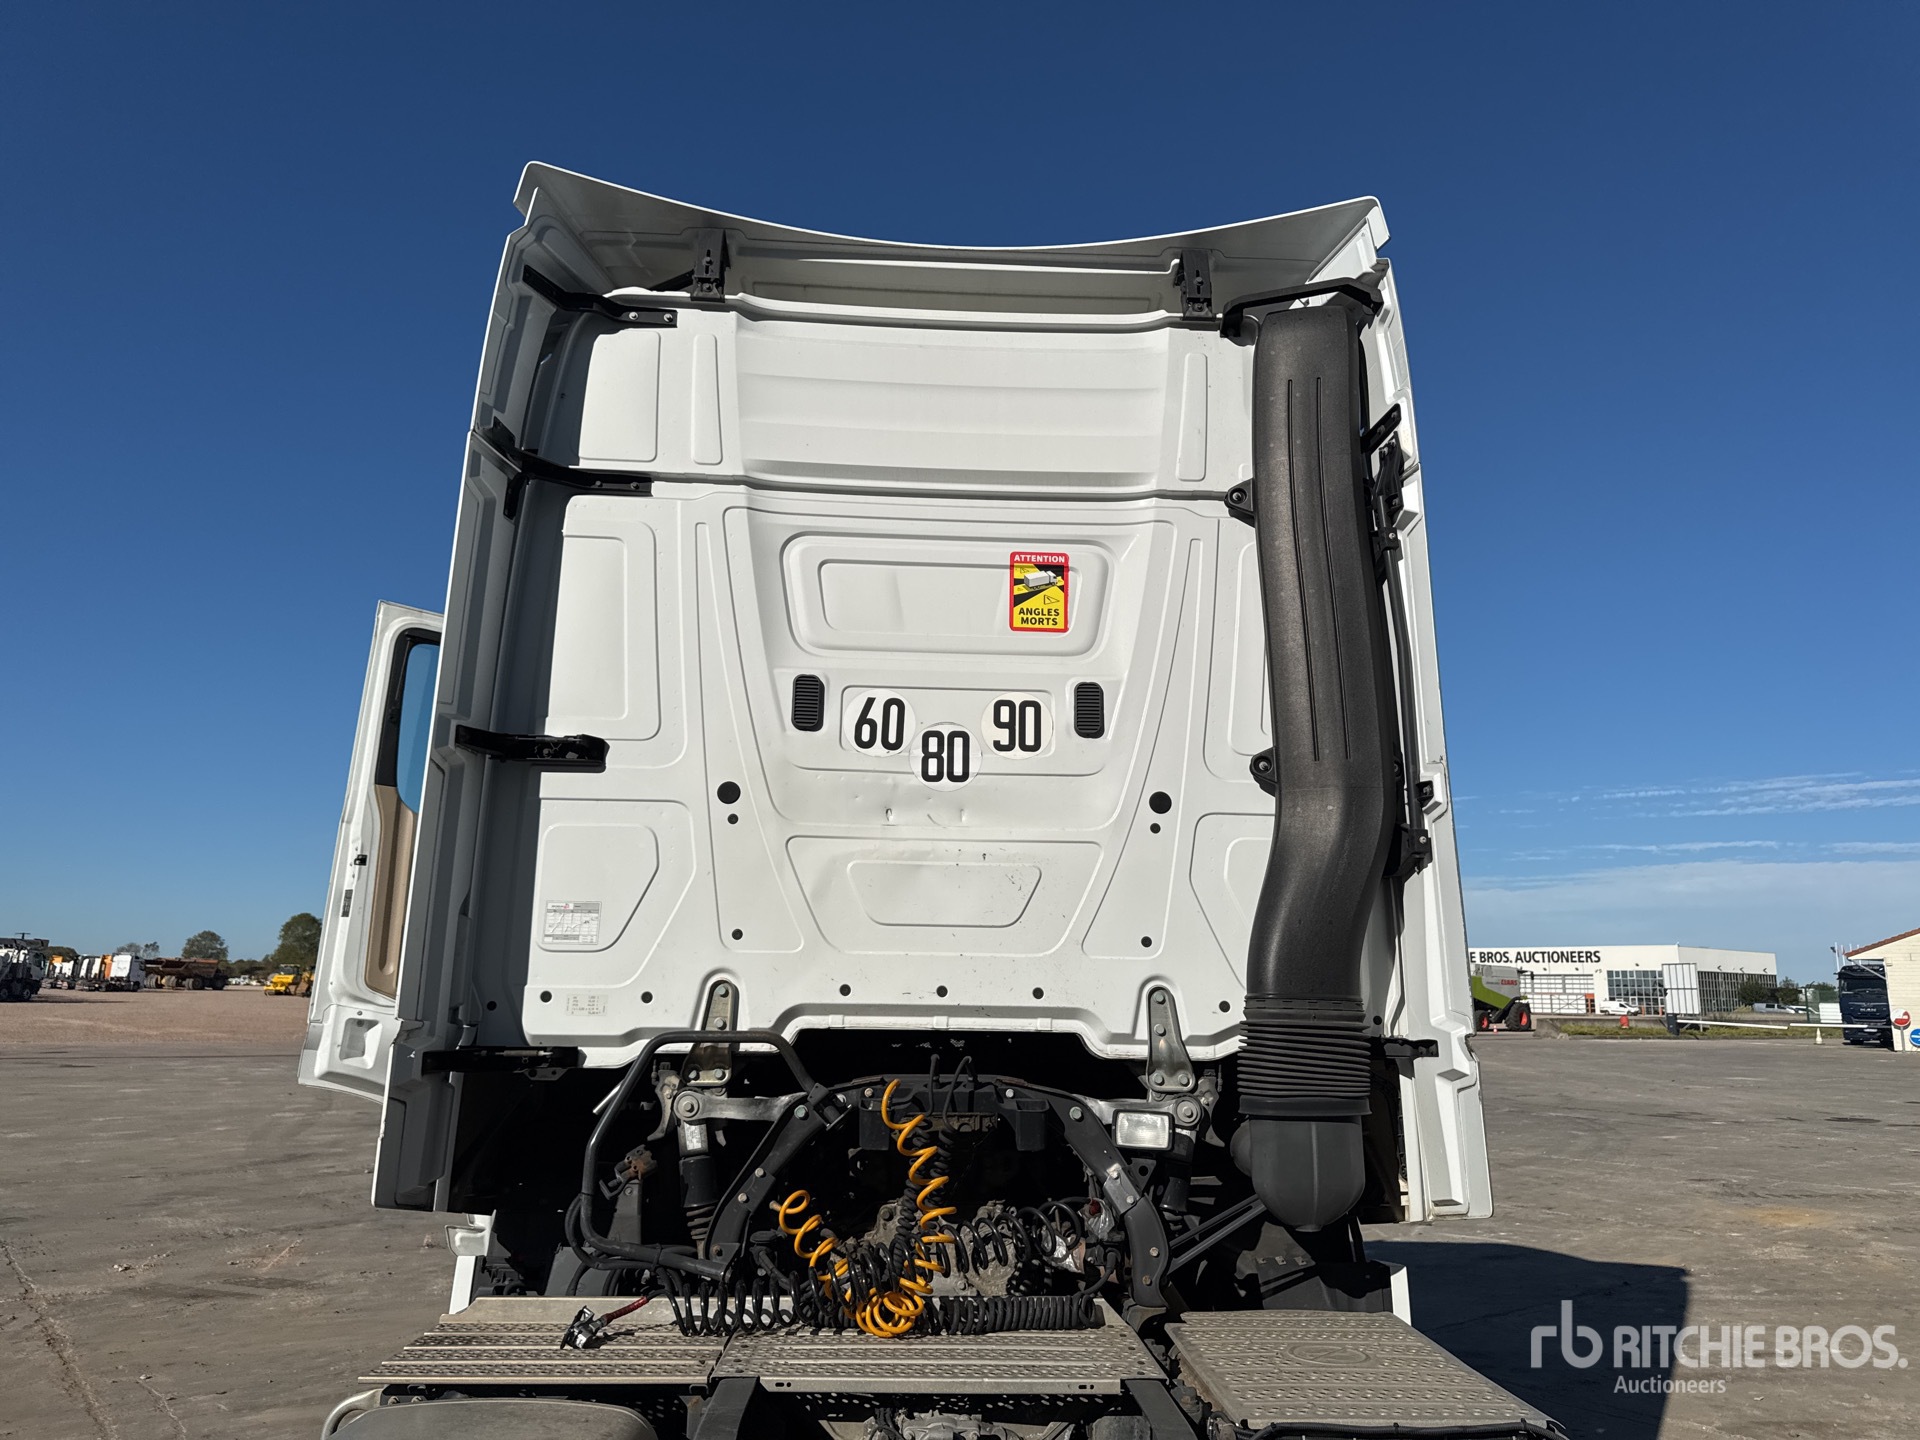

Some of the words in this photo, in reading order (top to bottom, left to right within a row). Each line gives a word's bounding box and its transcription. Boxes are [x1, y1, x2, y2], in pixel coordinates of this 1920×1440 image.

[1014, 554, 1065, 563] ATTENTION
[1018, 607, 1060, 617] ANGLES
[1020, 617, 1058, 626] MORTS
[854, 697, 906, 750] 60
[993, 699, 1042, 752] 90
[921, 730, 970, 782] 80
[1479, 951, 1513, 963] BROS.
[1515, 950, 1601, 963] AUCTIONEERS
